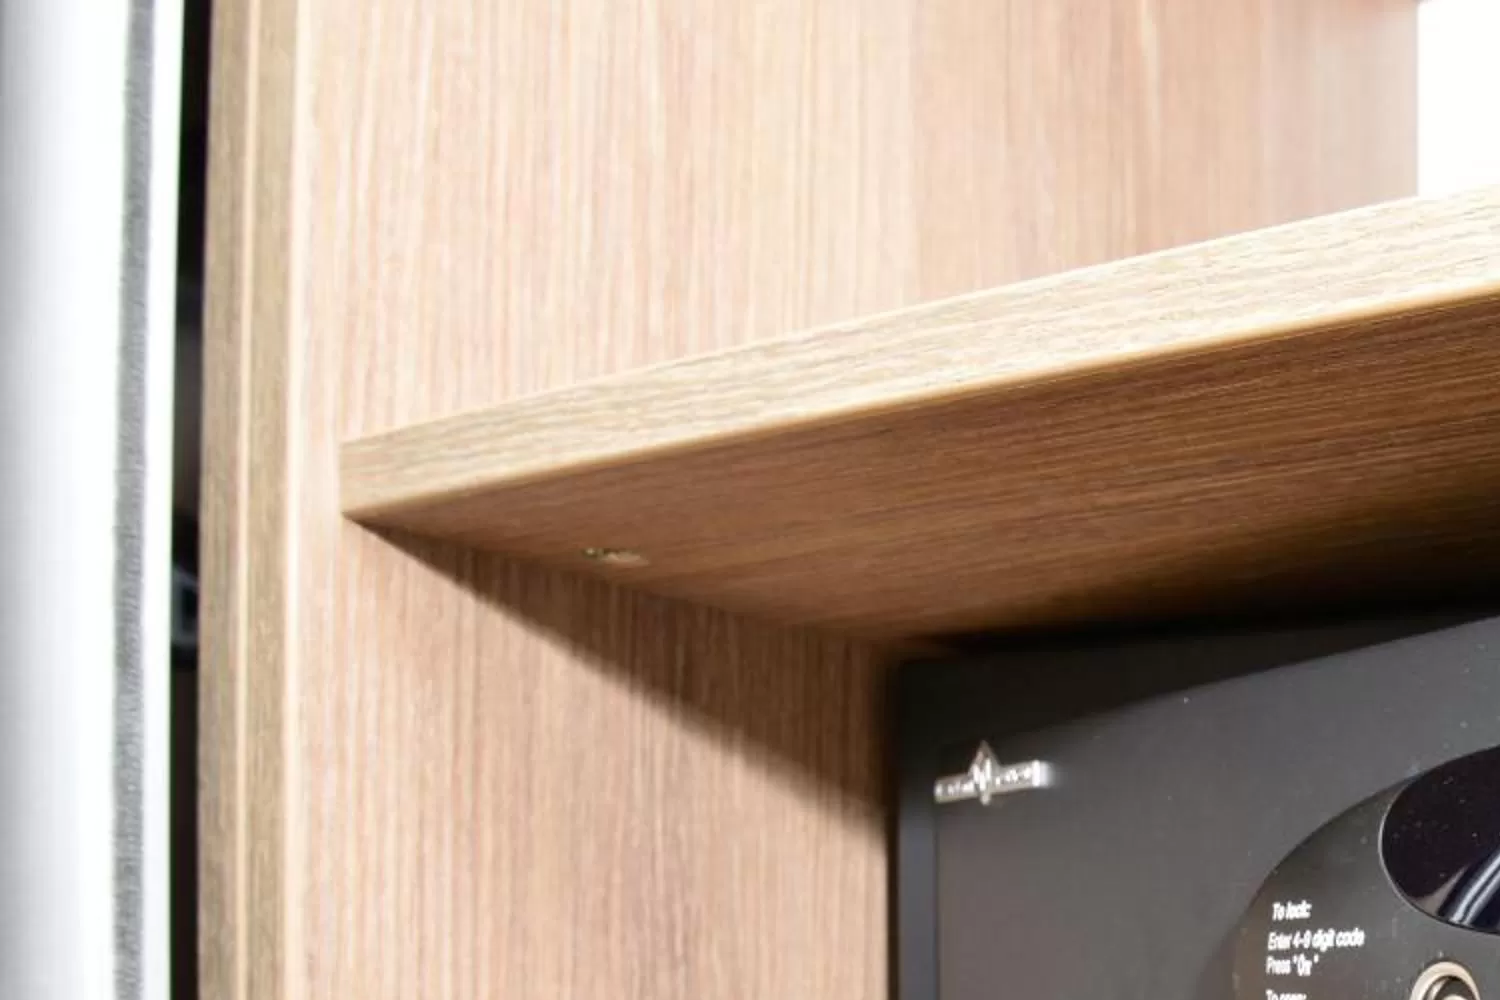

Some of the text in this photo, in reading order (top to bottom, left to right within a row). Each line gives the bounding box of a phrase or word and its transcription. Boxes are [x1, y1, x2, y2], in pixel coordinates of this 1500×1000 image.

[1272, 901, 1285, 920] To
[1268, 931, 1292, 950] Enter
[1312, 928, 1336, 952] digit
[1336, 927, 1364, 947] code
[1265, 955, 1291, 975] Press
